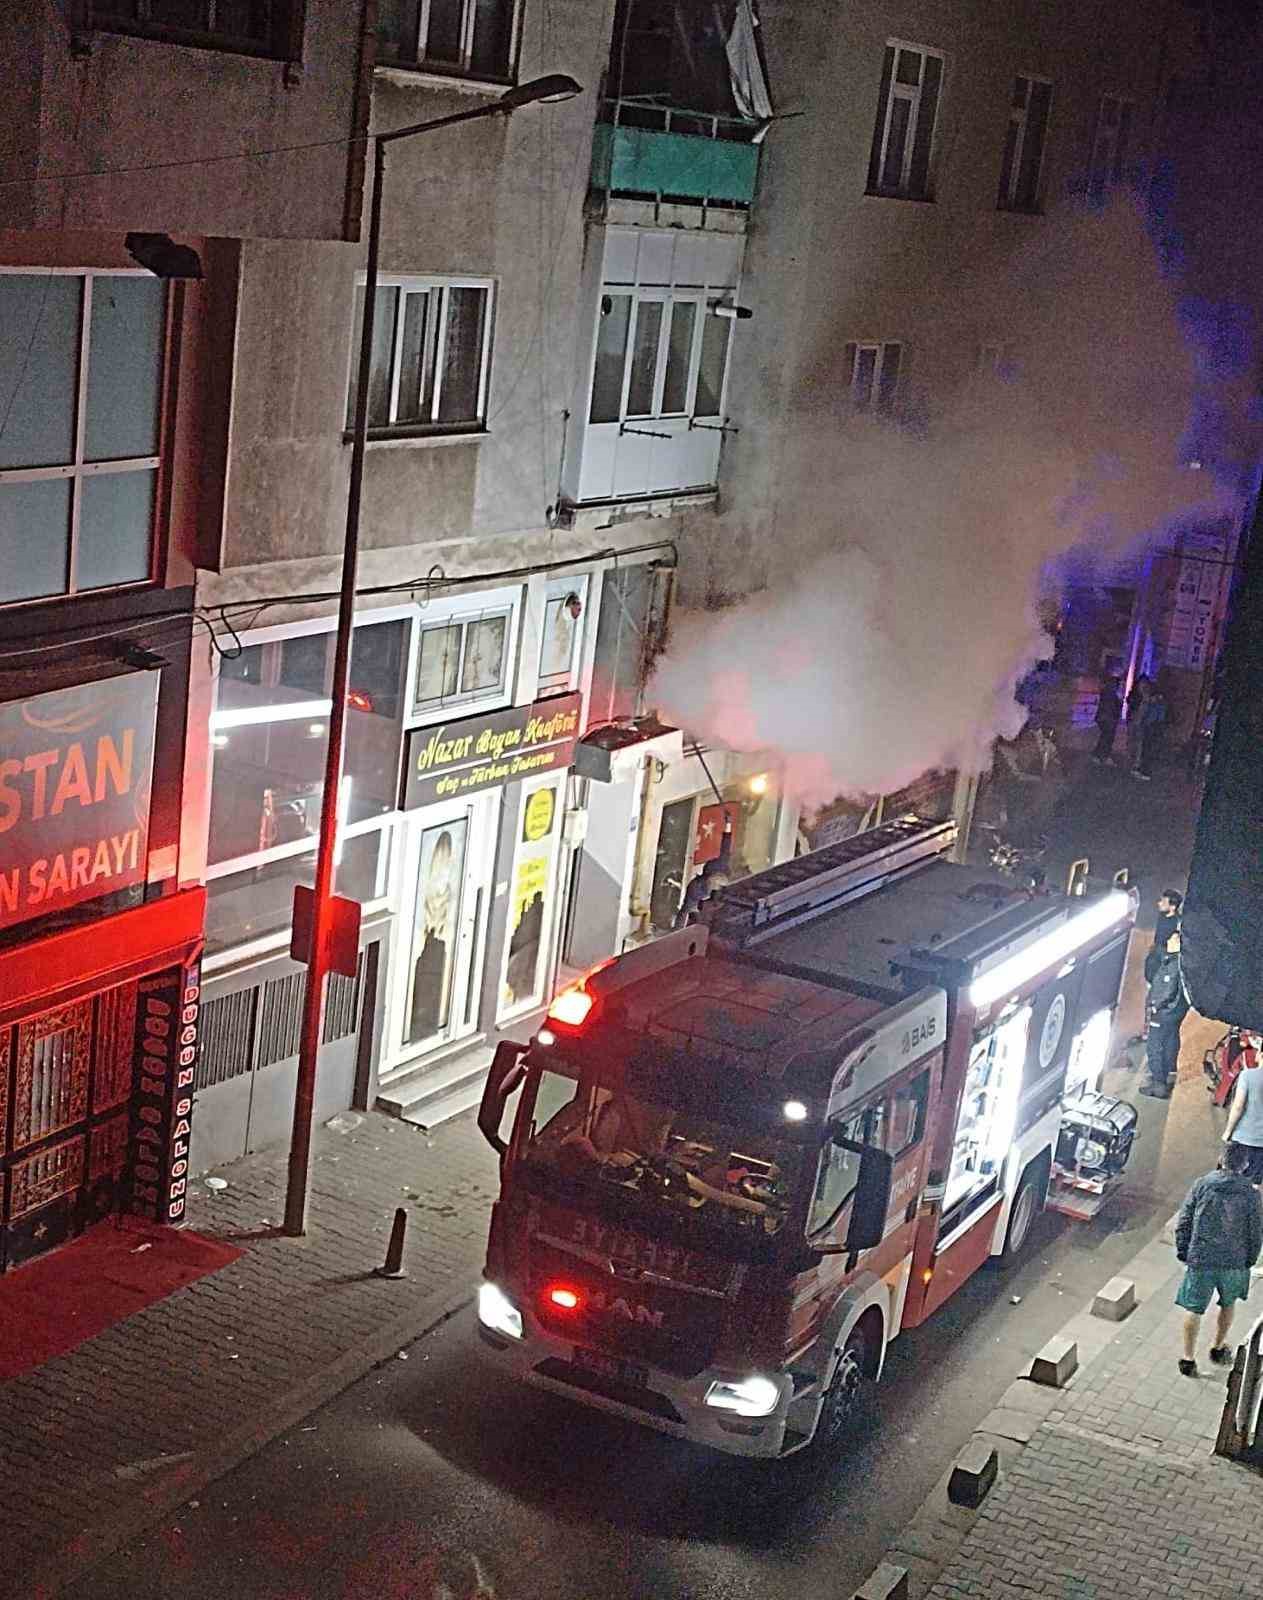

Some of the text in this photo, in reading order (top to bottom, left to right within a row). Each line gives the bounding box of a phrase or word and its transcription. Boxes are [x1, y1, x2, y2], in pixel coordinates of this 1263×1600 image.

[417, 726, 474, 770] Nazar
[475, 729, 521, 760] Bayan
[28, 829, 139, 904] SARAYI
[168, 1098, 191, 1218] SALONU
